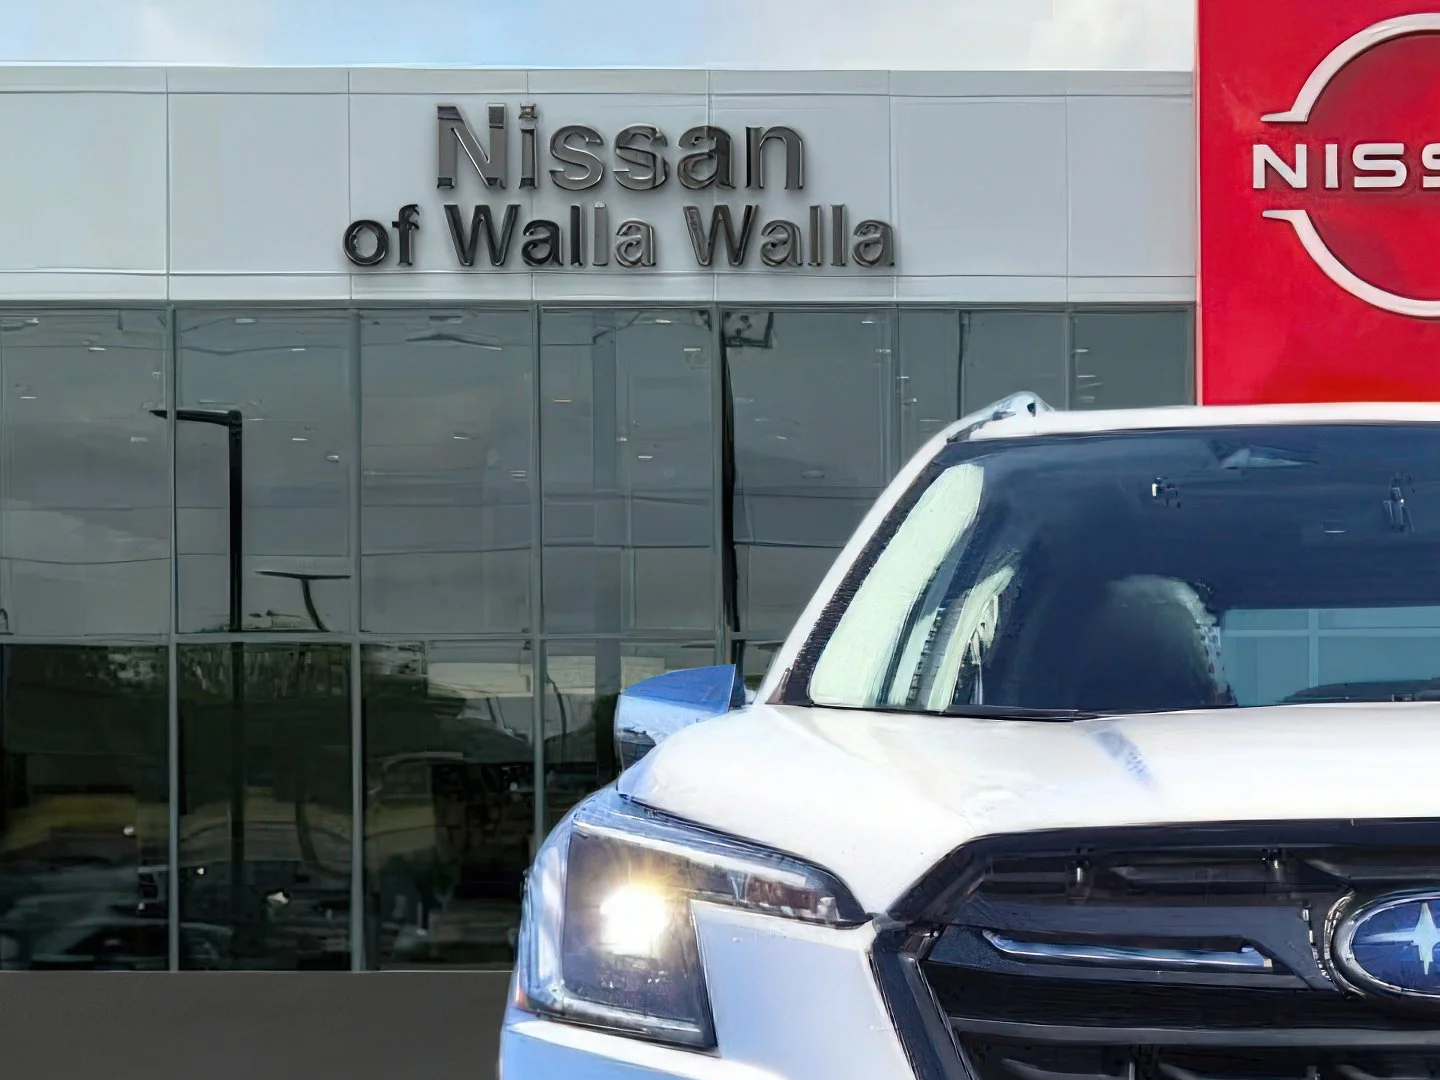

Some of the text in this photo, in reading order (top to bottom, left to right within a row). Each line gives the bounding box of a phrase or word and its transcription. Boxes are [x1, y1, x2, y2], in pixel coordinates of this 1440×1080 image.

[437, 103, 804, 190] Nissan
[342, 203, 896, 267] of Walla Walla
